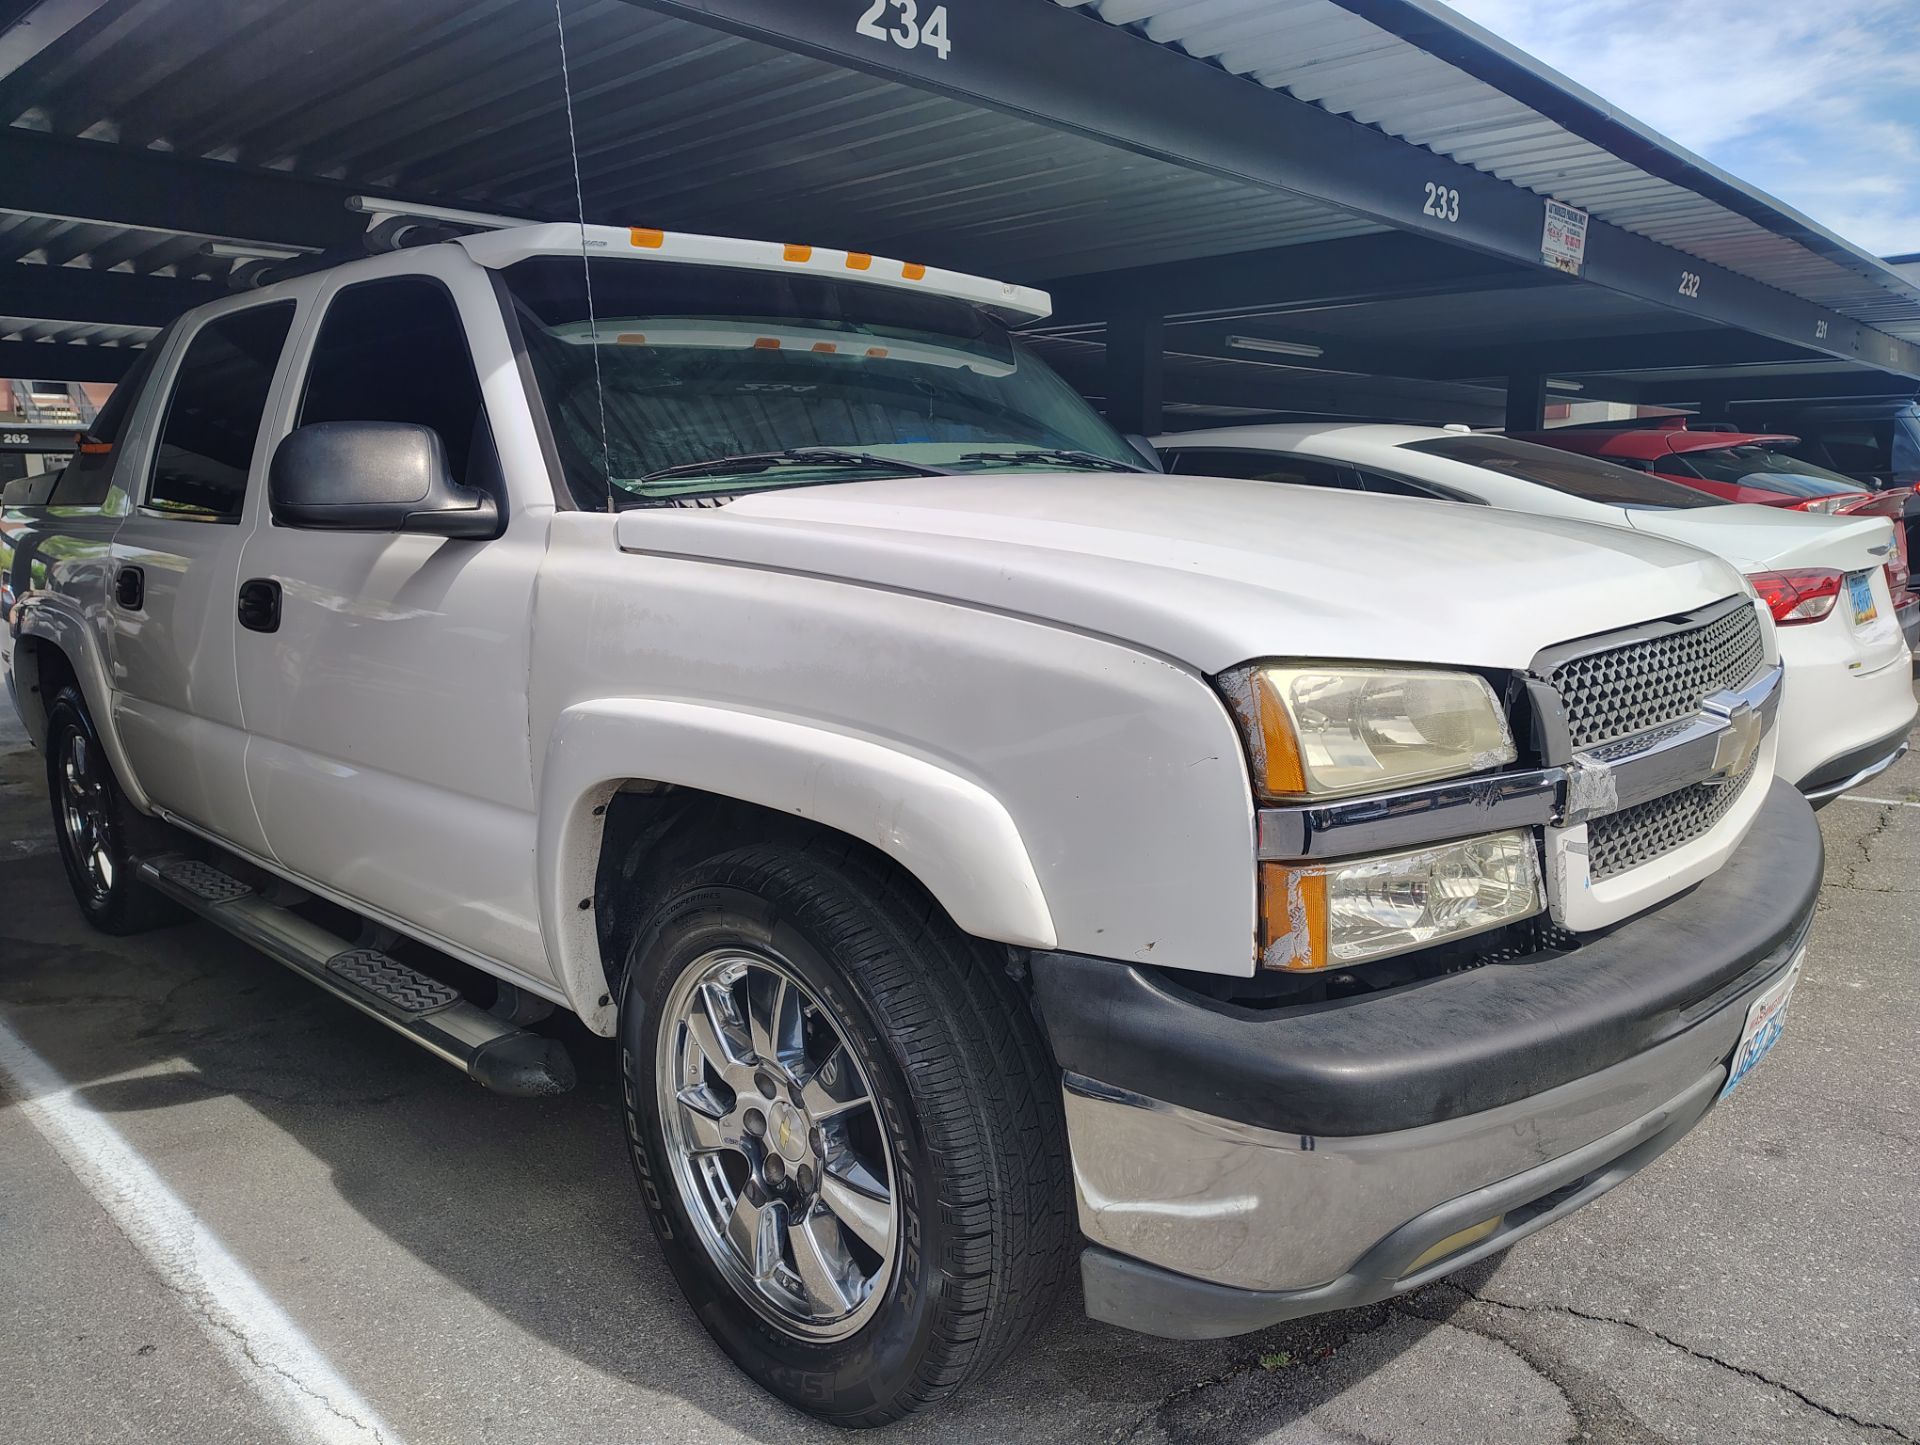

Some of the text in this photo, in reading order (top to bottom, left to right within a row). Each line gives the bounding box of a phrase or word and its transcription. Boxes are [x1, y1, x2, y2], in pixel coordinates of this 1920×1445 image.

[856, 0, 951, 60] 234
[1423, 181, 1460, 222] 233
[1678, 271, 1700, 298] 232
[1816, 320, 1828, 339] 231
[3, 433, 30, 444] 262
[622, 1047, 674, 1240] COOPER
